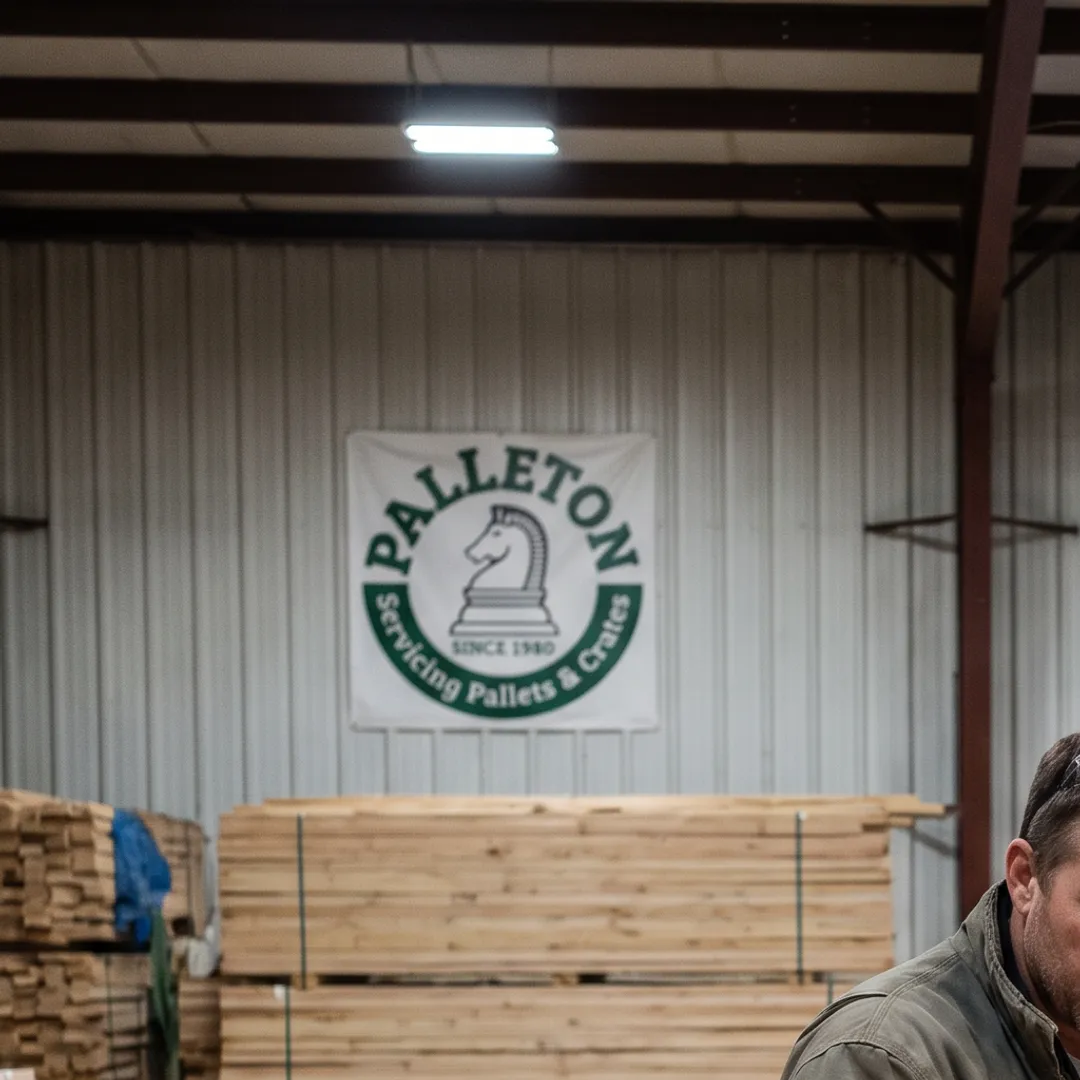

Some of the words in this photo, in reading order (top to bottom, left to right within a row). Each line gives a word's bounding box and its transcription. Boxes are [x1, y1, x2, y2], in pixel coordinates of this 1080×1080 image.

[365, 445, 640, 576] PALLETON
[376, 592, 463, 702] Servicing
[466, 679, 557, 708] Pallets
[557, 666, 582, 690] &
[577, 593, 631, 672] Crates
[452, 640, 505, 656] SINCE
